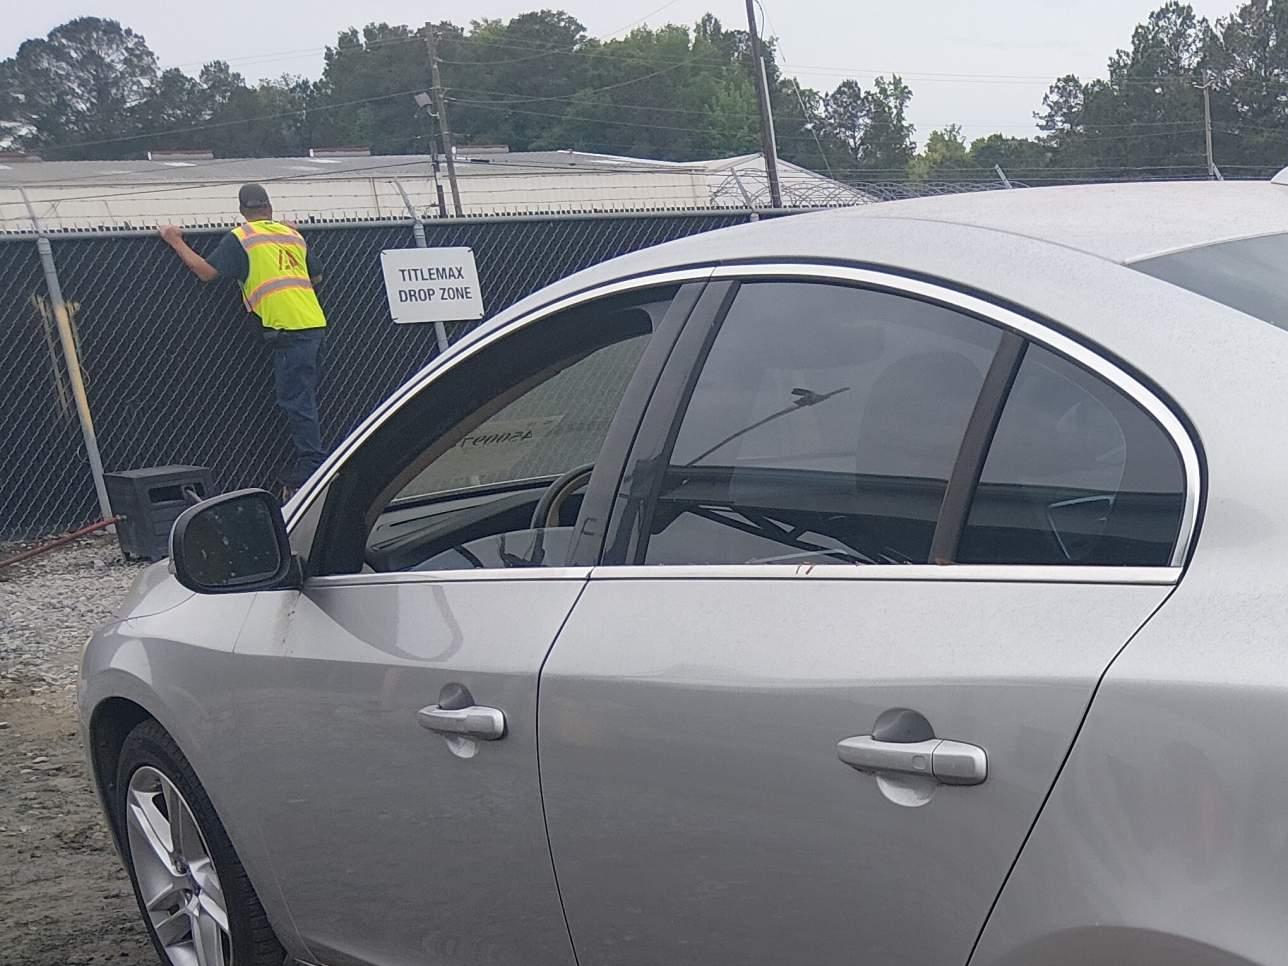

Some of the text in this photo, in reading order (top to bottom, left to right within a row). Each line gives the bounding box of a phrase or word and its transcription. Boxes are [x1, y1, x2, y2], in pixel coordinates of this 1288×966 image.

[398, 267, 464, 281] TITLEMAX
[398, 287, 473, 302] DROP ZONE
